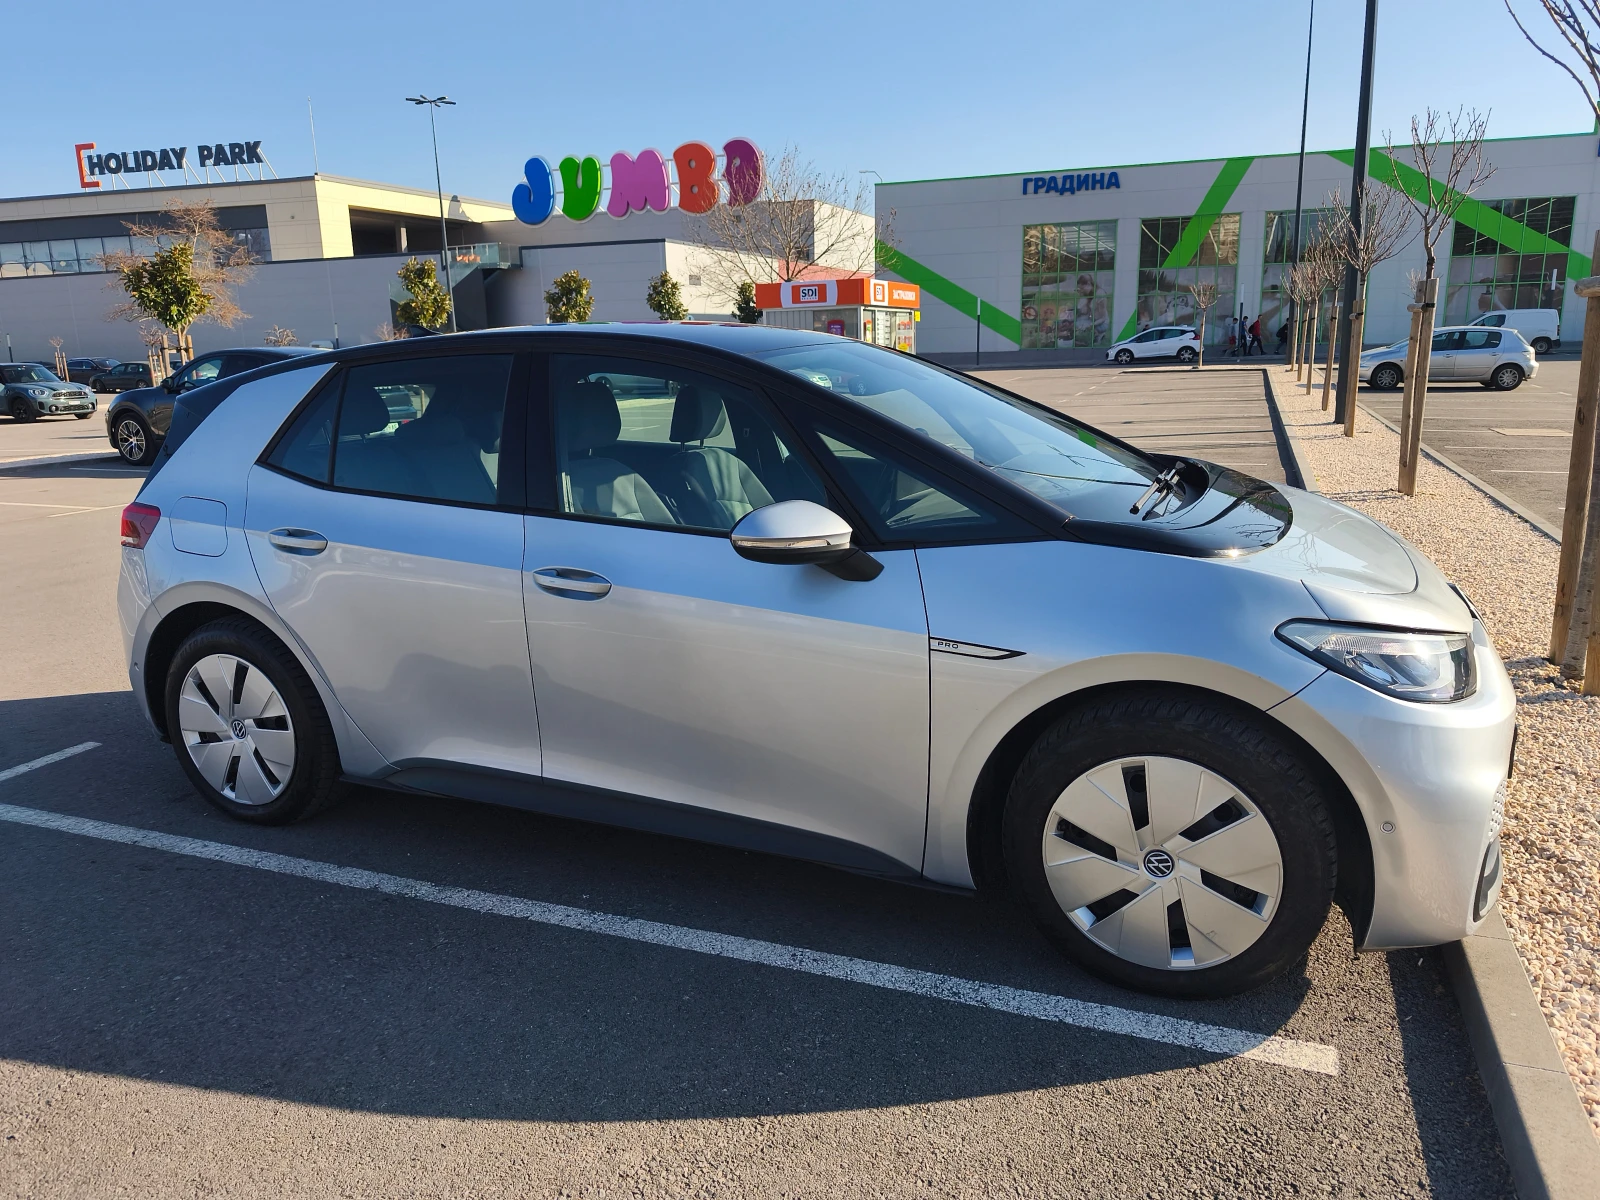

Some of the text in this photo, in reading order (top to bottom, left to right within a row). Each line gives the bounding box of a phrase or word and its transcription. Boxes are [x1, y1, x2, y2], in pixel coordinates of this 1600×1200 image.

[87, 141, 263, 176] HOLIDAY PARK
[511, 137, 762, 228] JUMBO
[1023, 171, 1120, 195] ГРАДИНА
[801, 288, 817, 297] SDI
[937, 641, 959, 649] PRO
